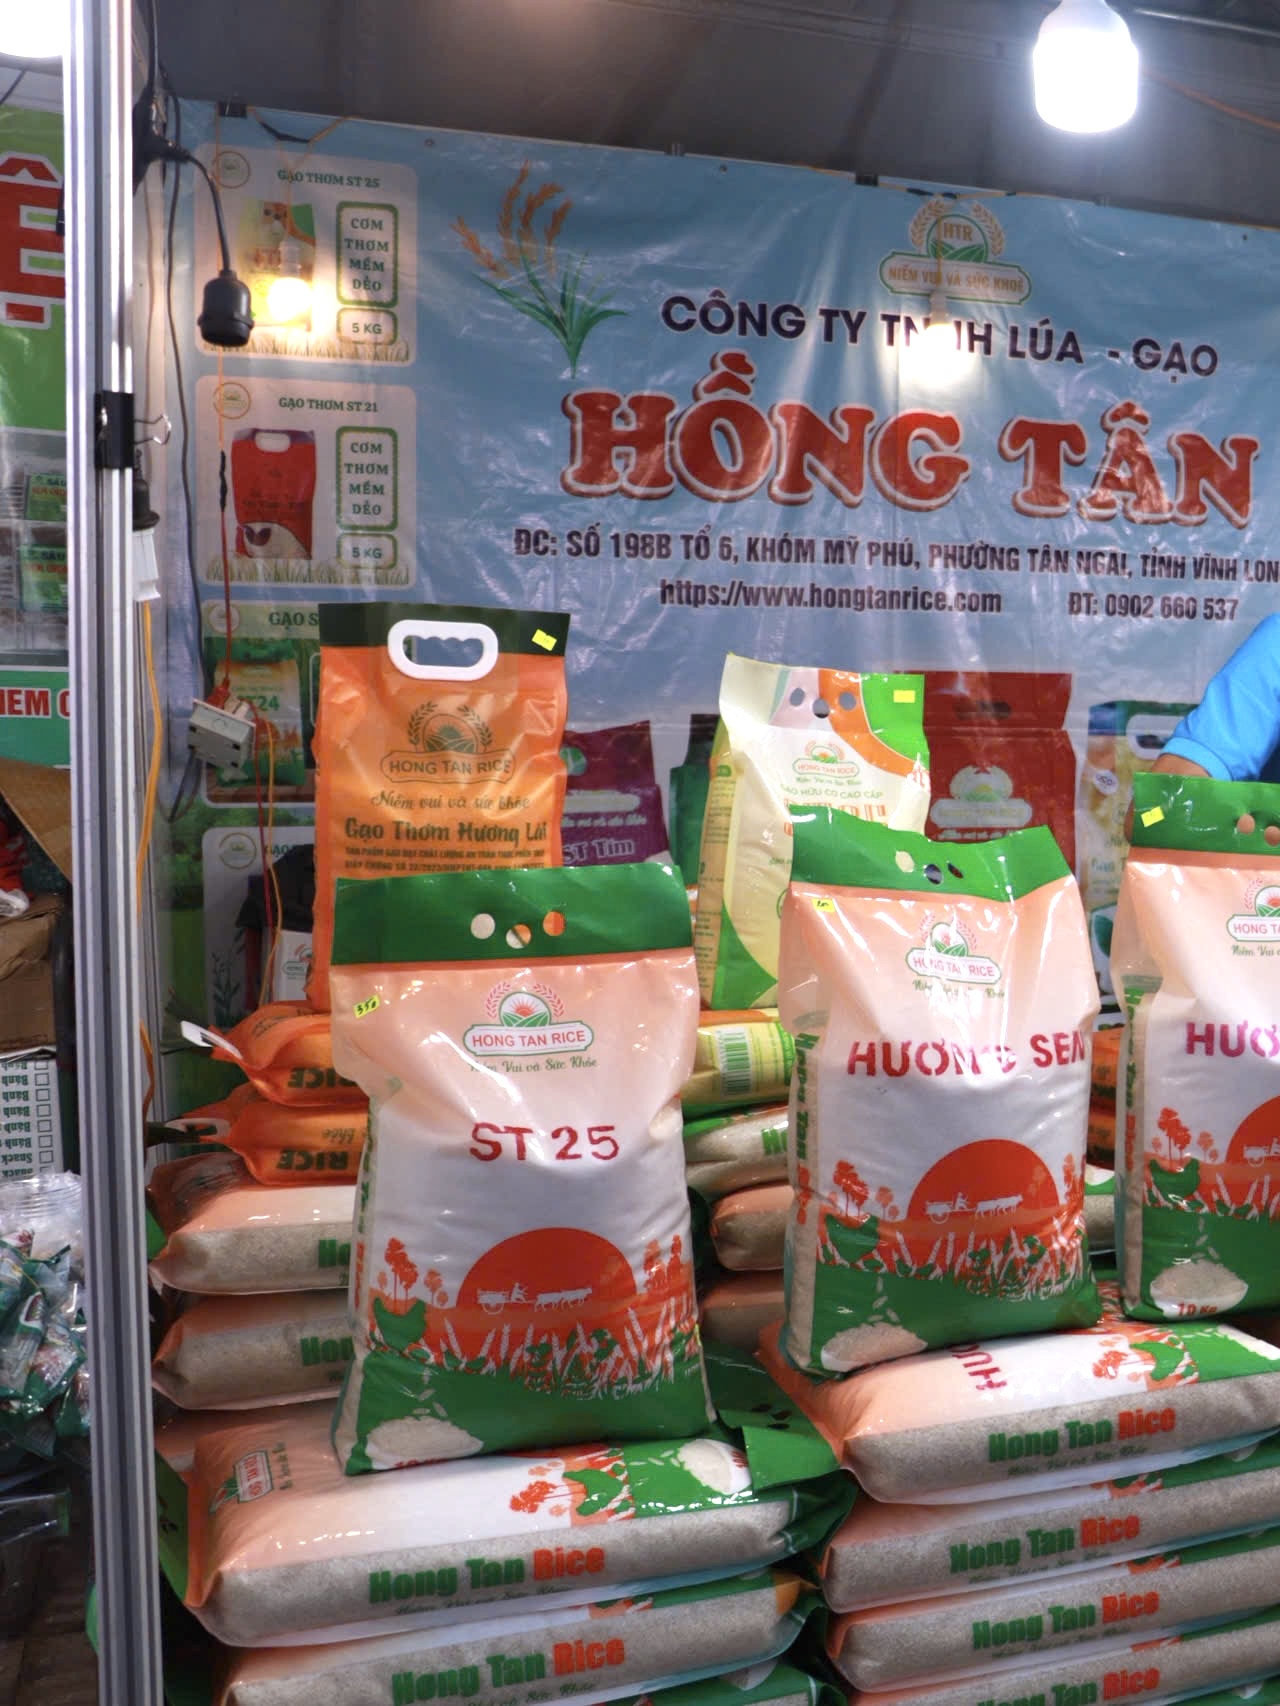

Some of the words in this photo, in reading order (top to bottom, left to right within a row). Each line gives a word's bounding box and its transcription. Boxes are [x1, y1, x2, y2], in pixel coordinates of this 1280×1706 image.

[344, 175, 365, 187] ST
[365, 177, 380, 188] 25
[350, 217, 383, 231] CƠM
[943, 222, 973, 241] HTR
[344, 237, 389, 252] THƠM
[352, 322, 360, 334] 5
[363, 322, 382, 334] KG
[660, 289, 806, 338] CÔNG
[819, 309, 868, 344] TY
[880, 313, 993, 356] TNH
[1009, 318, 1084, 364] LÚA
[1131, 337, 1218, 383] GẠO
[279, 397, 304, 411] GẠO
[307, 399, 345, 412] THƠM
[346, 401, 364, 412] ST
[365, 402, 378, 412] 21
[350, 442, 383, 455] CƠM
[562, 351, 971, 512] HỒNG
[1000, 399, 1260, 530] TÂN
[344, 463, 389, 475] THƠM
[352, 546, 360, 559] 5
[363, 547, 382, 559] KG
[514, 528, 558, 557] ĐC:
[566, 522, 601, 559] SỐ
[610, 532, 673, 560] 198B
[680, 523, 711, 562] TỔ
[718, 536, 739, 564] 6,
[746, 530, 816, 564] KHÓM
[822, 534, 859, 566] MỸ
[866, 533, 921, 570] PHÚ,
[928, 543, 1020, 572] PHƯỜNG
[1026, 544, 1070, 574] TÂN
[1140, 546, 1186, 581] TỈNH
[1191, 555, 1238, 583] VĨNH
[659, 579, 1002, 614] https://www.hongtanrice.com
[1067, 592, 1099, 617] ĐT:
[1104, 593, 1154, 619] 0902
[1160, 597, 1198, 620] 660
[1202, 598, 1239, 622] 537
[269, 610, 305, 630] GẠO
[389, 759, 438, 775] HONG
[443, 761, 473, 775] TAN
[476, 759, 511, 774] RICE
[344, 816, 385, 843] Gạo
[391, 819, 450, 842] Thơm
[457, 821, 521, 849] Hương
[1232, 923, 1268, 934] HONG
[968, 964, 995, 977] RICE
[472, 1034, 516, 1048] HONG
[518, 1034, 548, 1047] TAN
[551, 1029, 587, 1044] RICE
[1030, 1029, 1086, 1069] SEN
[469, 1122, 534, 1162] ST
[550, 1124, 622, 1162] 25
[276, 1147, 350, 1172] RICE
[1177, 1302, 1197, 1317] 10
[1064, 1419, 1113, 1449] Tan
[1117, 1407, 1176, 1440] Rice
[1026, 1527, 1076, 1559] Tan
[1080, 1514, 1141, 1549] Rice
[369, 1566, 458, 1605] Hong
[464, 1557, 526, 1590] Tan
[533, 1546, 606, 1581] Rice
[1048, 1603, 1097, 1634] Tan
[1102, 1591, 1161, 1625] Rice
[391, 1664, 481, 1703] Hong
[486, 1653, 547, 1689] Tan
[552, 1637, 626, 1677] Rice
[1102, 1667, 1161, 1701] Rice
